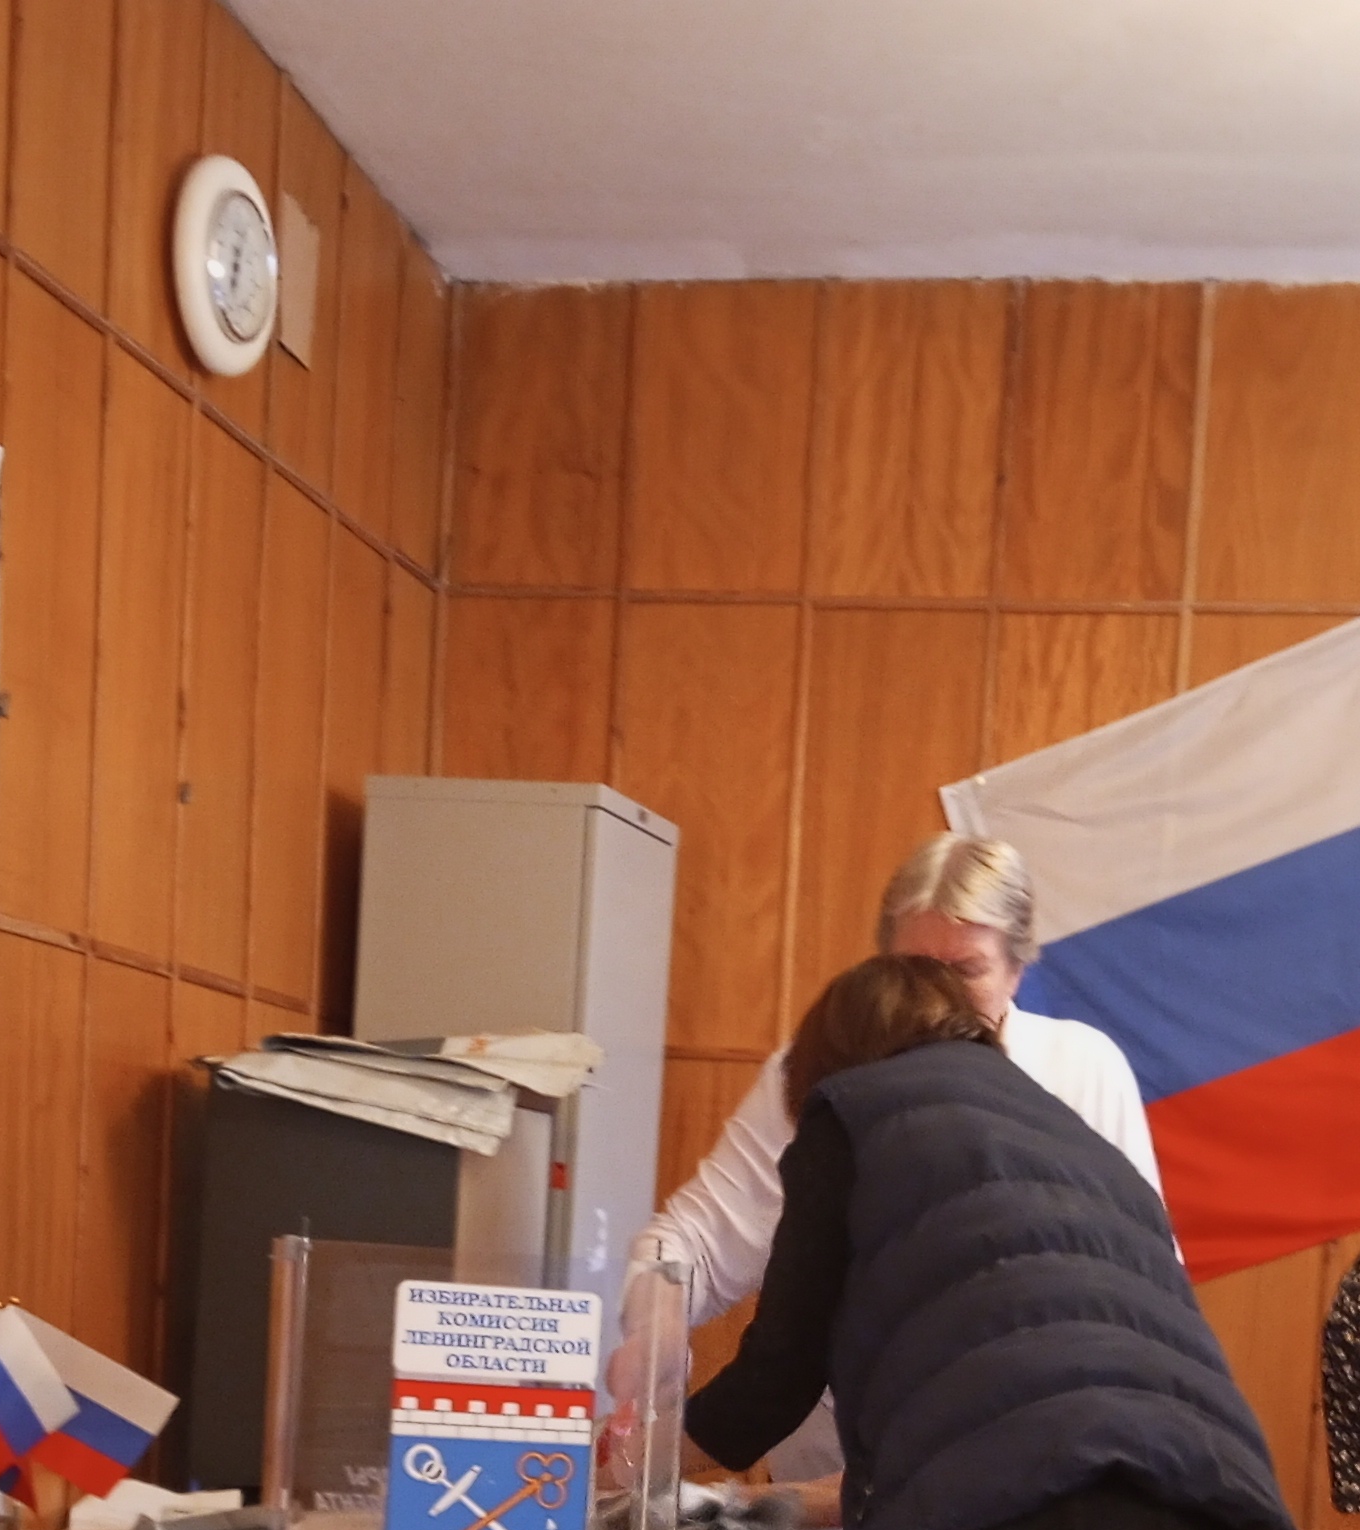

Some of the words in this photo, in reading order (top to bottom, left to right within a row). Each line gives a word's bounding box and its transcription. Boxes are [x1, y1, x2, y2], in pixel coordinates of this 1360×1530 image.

[408, 1287, 591, 1314] ИЗБИРАТЕЛЬНАЯ
[437, 1311, 560, 1333] КОМИССИЯ
[402, 1329, 591, 1356] ЛЕНИНГРАДСКОЙ
[446, 1353, 547, 1374] ОБЛАСТИ
